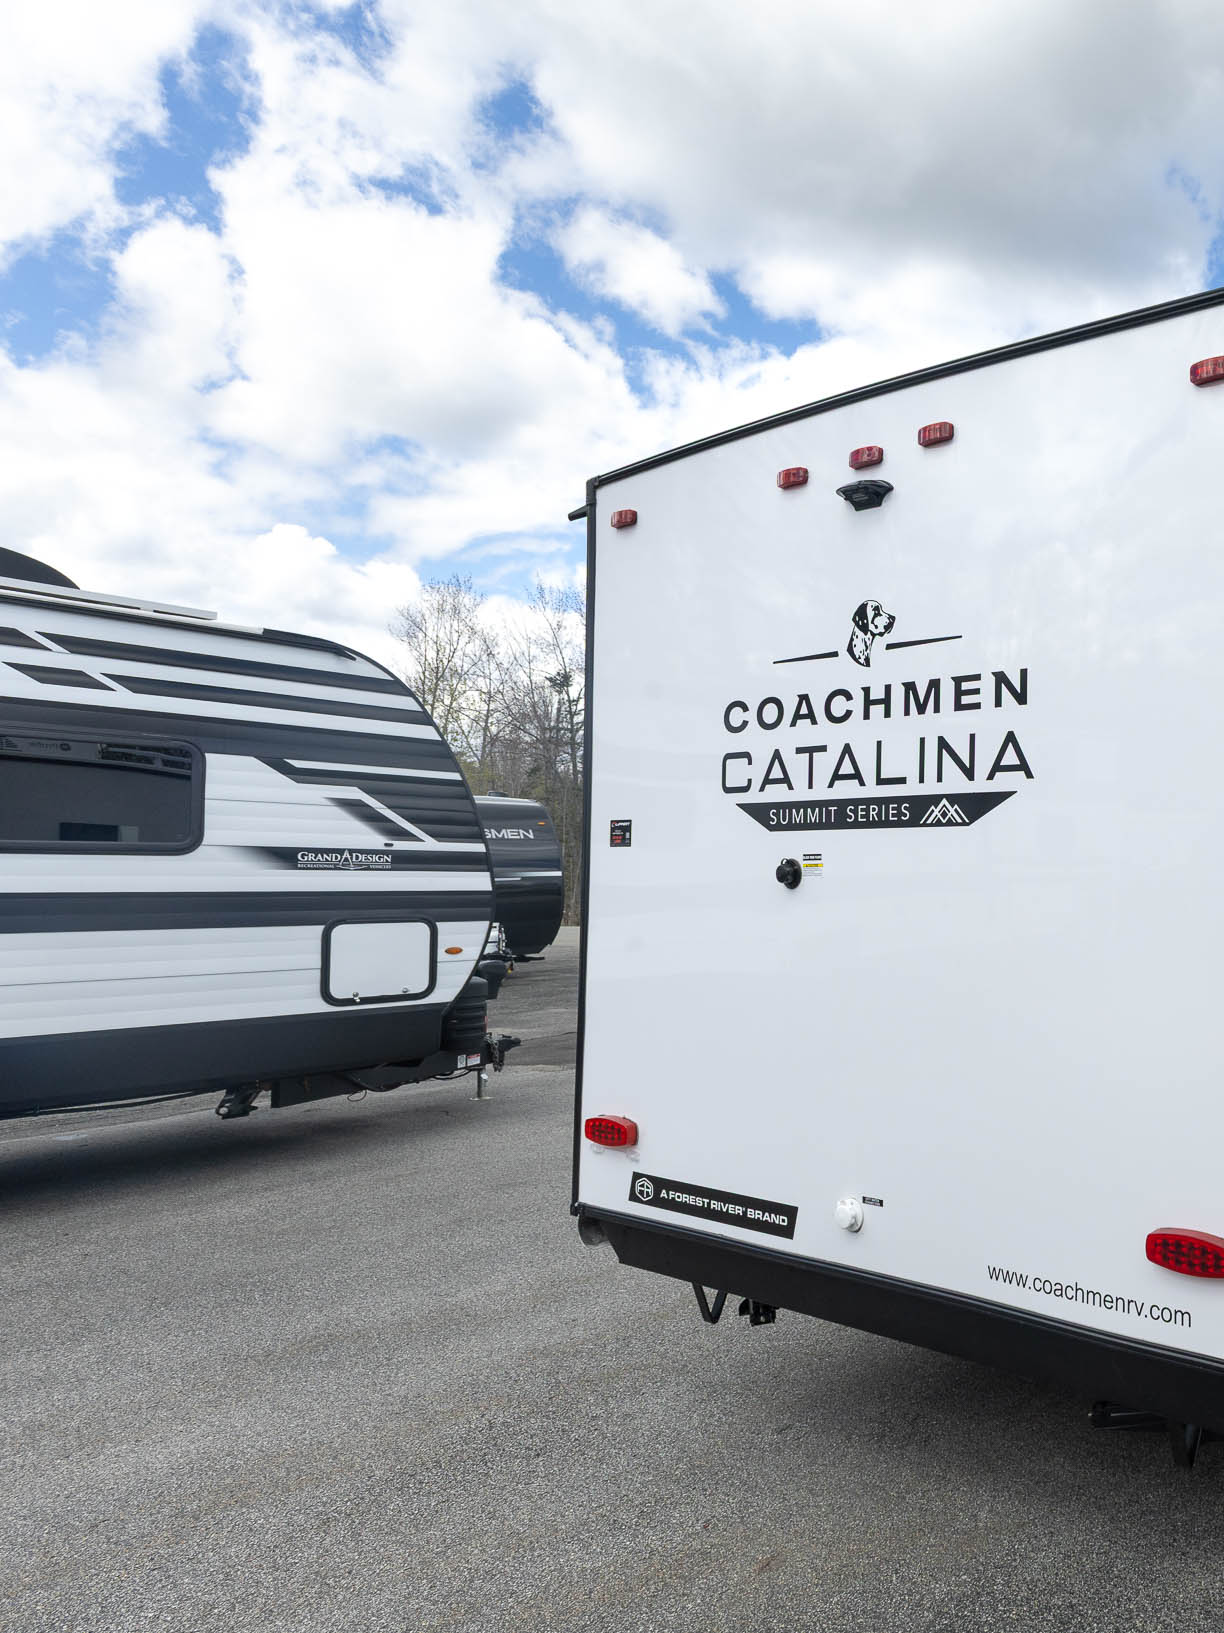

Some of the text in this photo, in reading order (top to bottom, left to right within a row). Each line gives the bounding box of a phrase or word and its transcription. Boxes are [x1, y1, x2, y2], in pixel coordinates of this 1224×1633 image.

[723, 668, 1029, 734] COACHMEN
[721, 730, 1035, 794] CATALINA
[769, 803, 910, 825] SUMMIT SERIES
[297, 851, 392, 862] GRAND DESIGN
[660, 1189, 668, 1199] A
[669, 1190, 710, 1208] FOREST
[747, 1208, 788, 1226] BRAND
[987, 1265, 1192, 1328] www.coachmenrv.com
